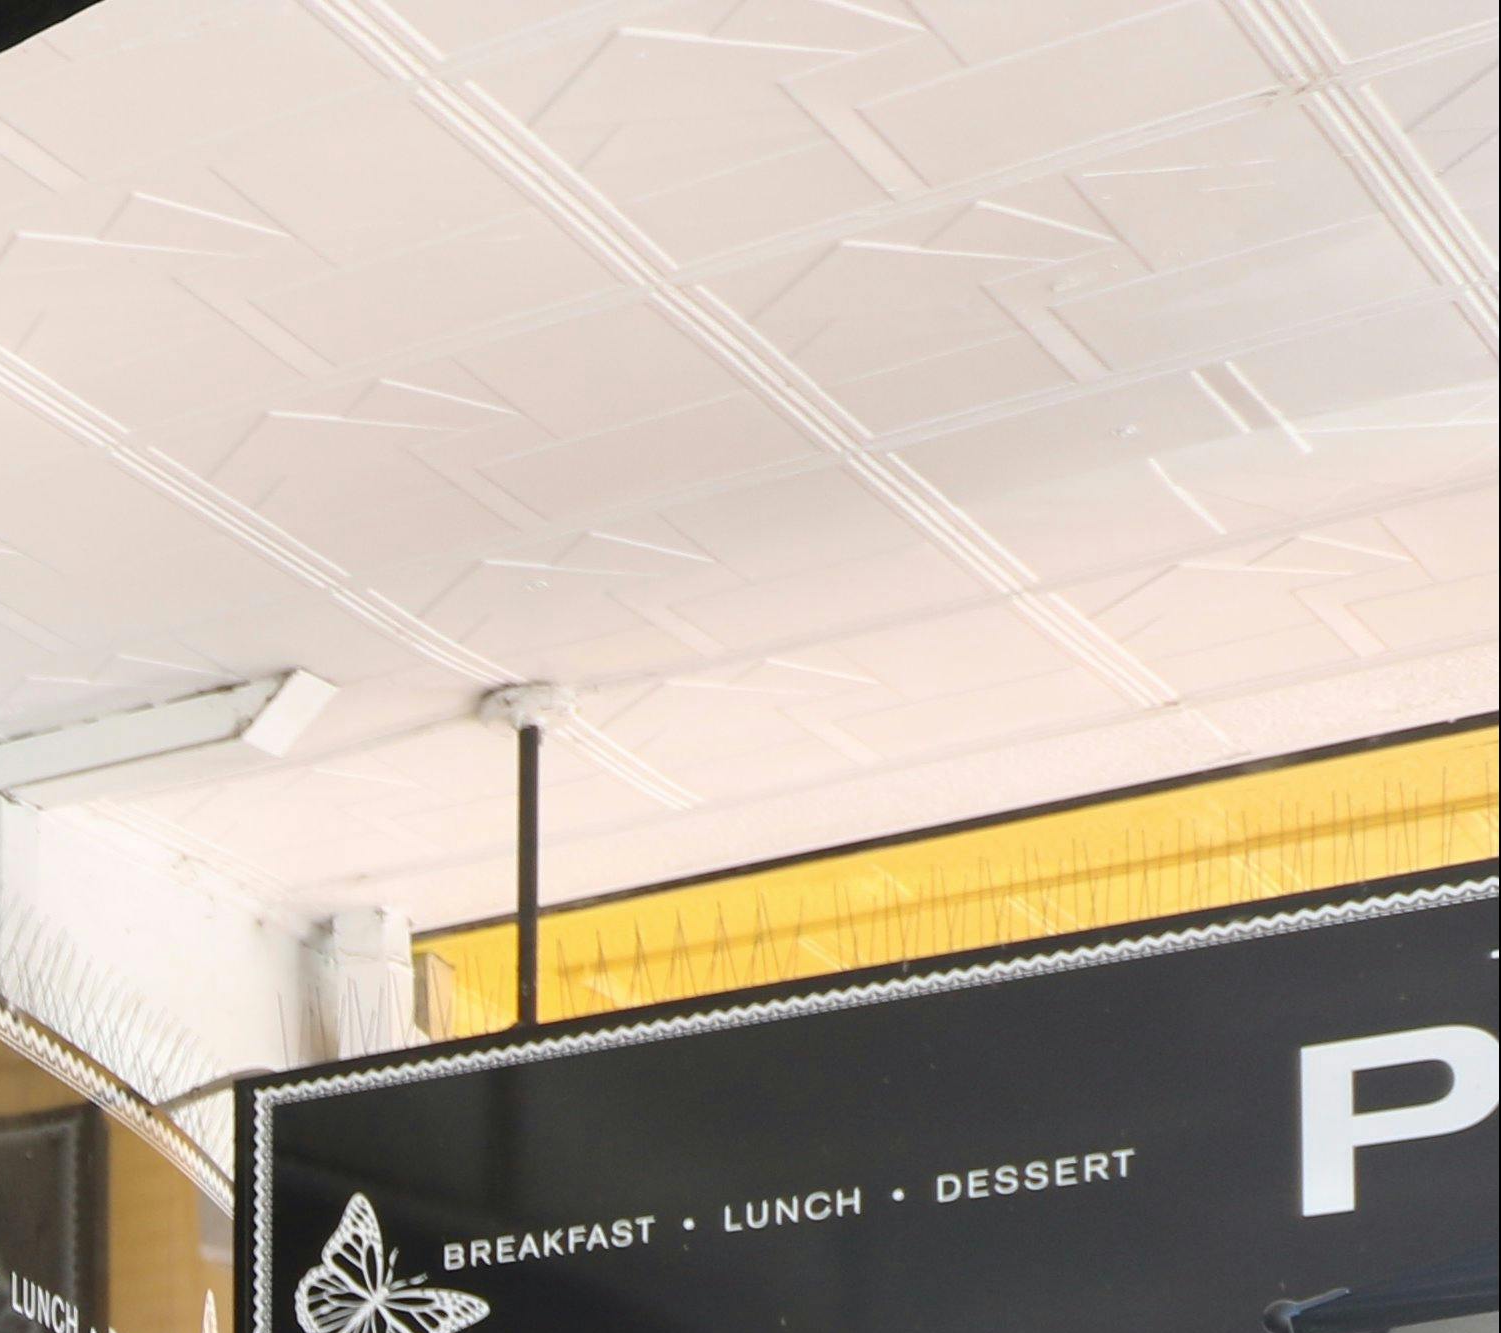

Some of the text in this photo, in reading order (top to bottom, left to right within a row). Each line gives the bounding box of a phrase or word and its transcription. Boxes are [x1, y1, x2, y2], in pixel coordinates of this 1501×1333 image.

[443, 1148, 1136, 1270] BREAKFAST LUNCH DESSERT
